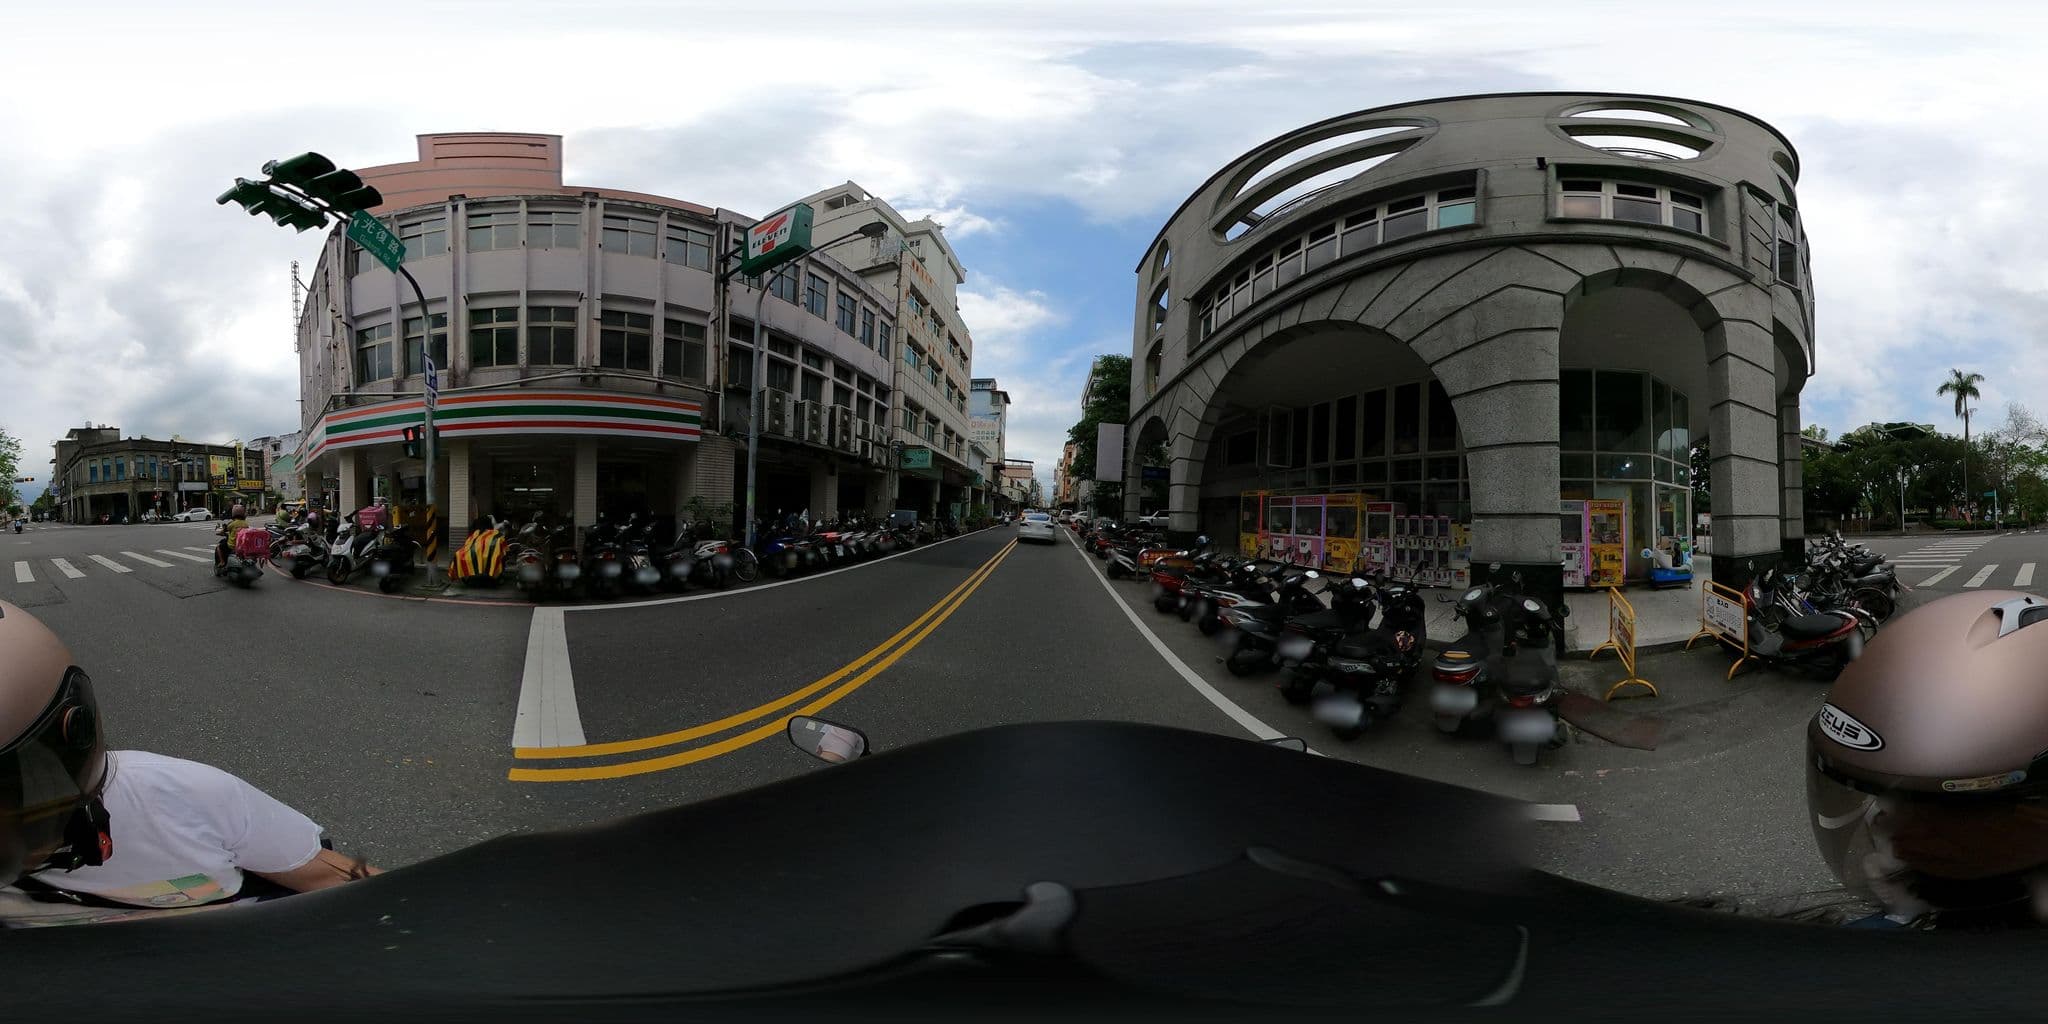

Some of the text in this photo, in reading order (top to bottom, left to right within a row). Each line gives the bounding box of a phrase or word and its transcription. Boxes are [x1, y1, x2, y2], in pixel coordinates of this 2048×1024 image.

[361, 218, 399, 254] 光復路
[1821, 706, 1861, 740] ZEUS
